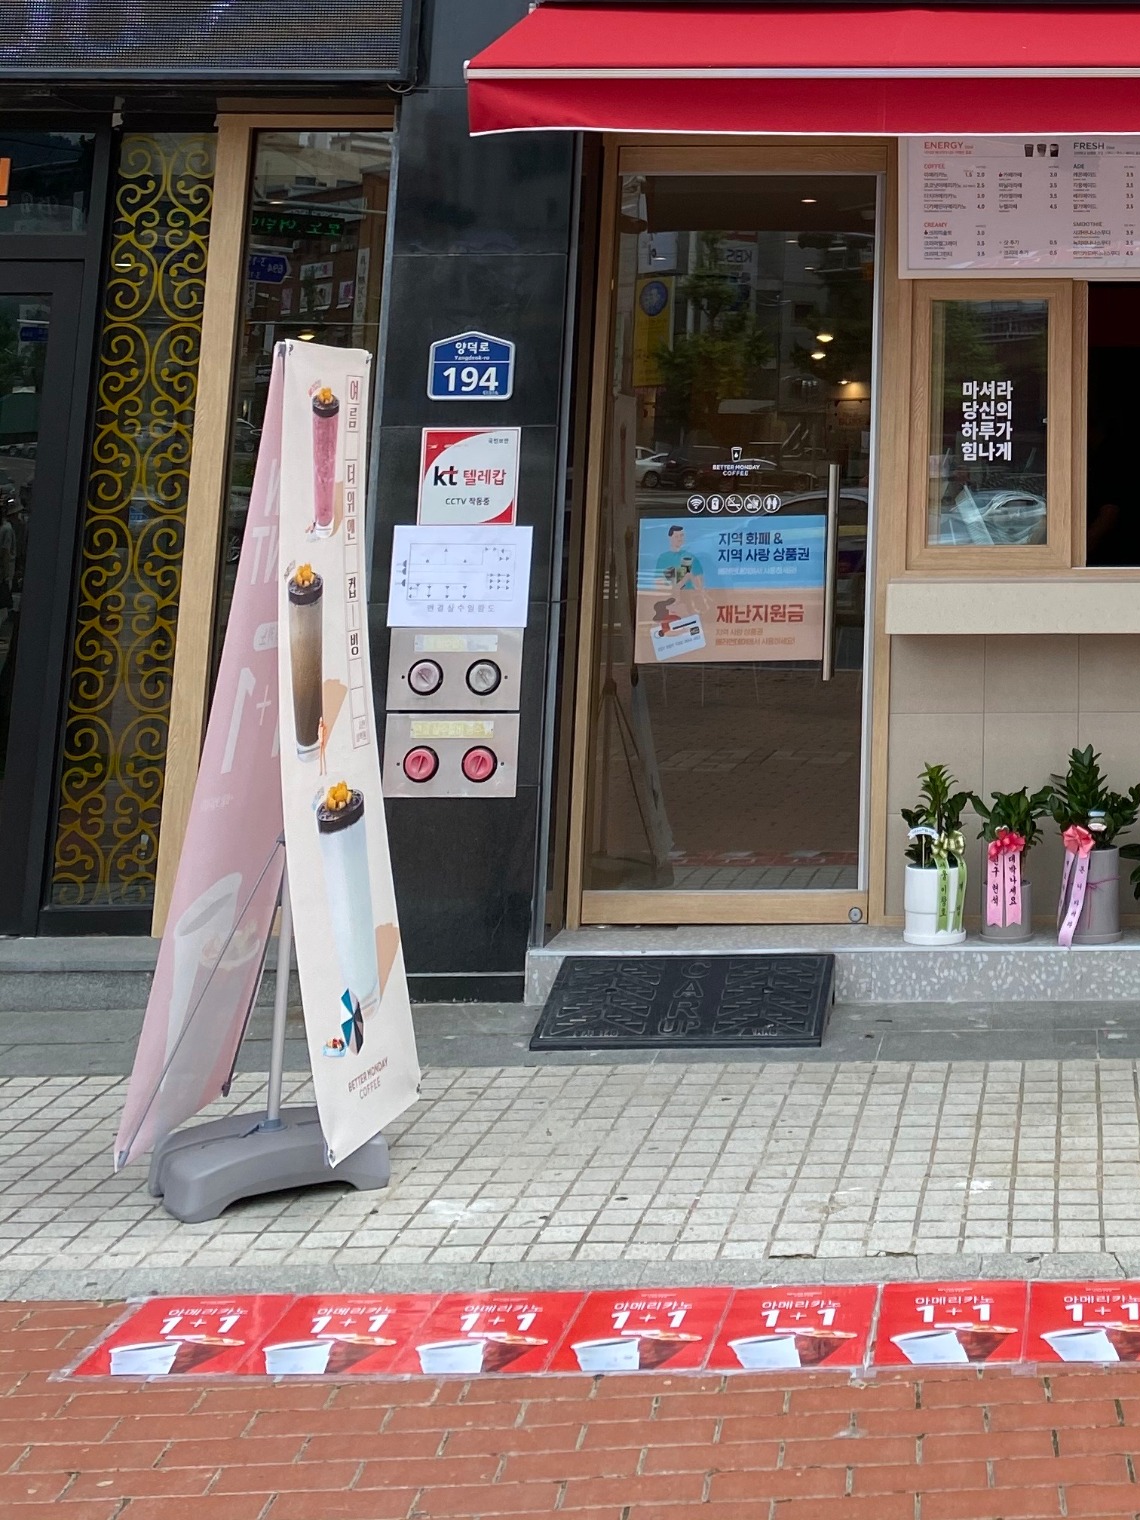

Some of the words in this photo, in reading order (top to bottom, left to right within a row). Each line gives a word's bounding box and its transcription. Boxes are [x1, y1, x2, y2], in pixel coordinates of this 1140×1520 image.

[455, 342, 490, 355] 양덕로
[443, 366, 499, 392] 194
[962, 380, 1014, 400] 마셔라
[962, 400, 1012, 420] 당신의
[961, 421, 1014, 440] 하루가
[961, 441, 1012, 461] 힘나게
[433, 465, 459, 486] kt
[463, 468, 507, 486] 텔레캅
[445, 498, 467, 506] CCTV
[468, 497, 490, 506] 작동중
[718, 532, 743, 546] 지역
[746, 532, 771, 546] 화폐
[773, 533, 783, 545] &
[718, 548, 743, 562] 지역
[745, 548, 770, 562] 사랑
[773, 548, 810, 562] 상품권
[716, 604, 804, 624] 재난지원금
[1008, 853, 1017, 906] 대박나세요
[348, 1071, 367, 1093] BETTER
[367, 1056, 388, 1079] MONDAY
[359, 1076, 381, 1100] COFFEE
[465, 1303, 543, 1313] 아메리카노
[614, 1301, 693, 1311] 아메리카노
[761, 1300, 841, 1310] 아메리카노
[915, 1295, 994, 1306] 아메리카노
[168, 1306, 249, 1316] 아메리카노
[316, 1306, 397, 1316] 아메리카노
